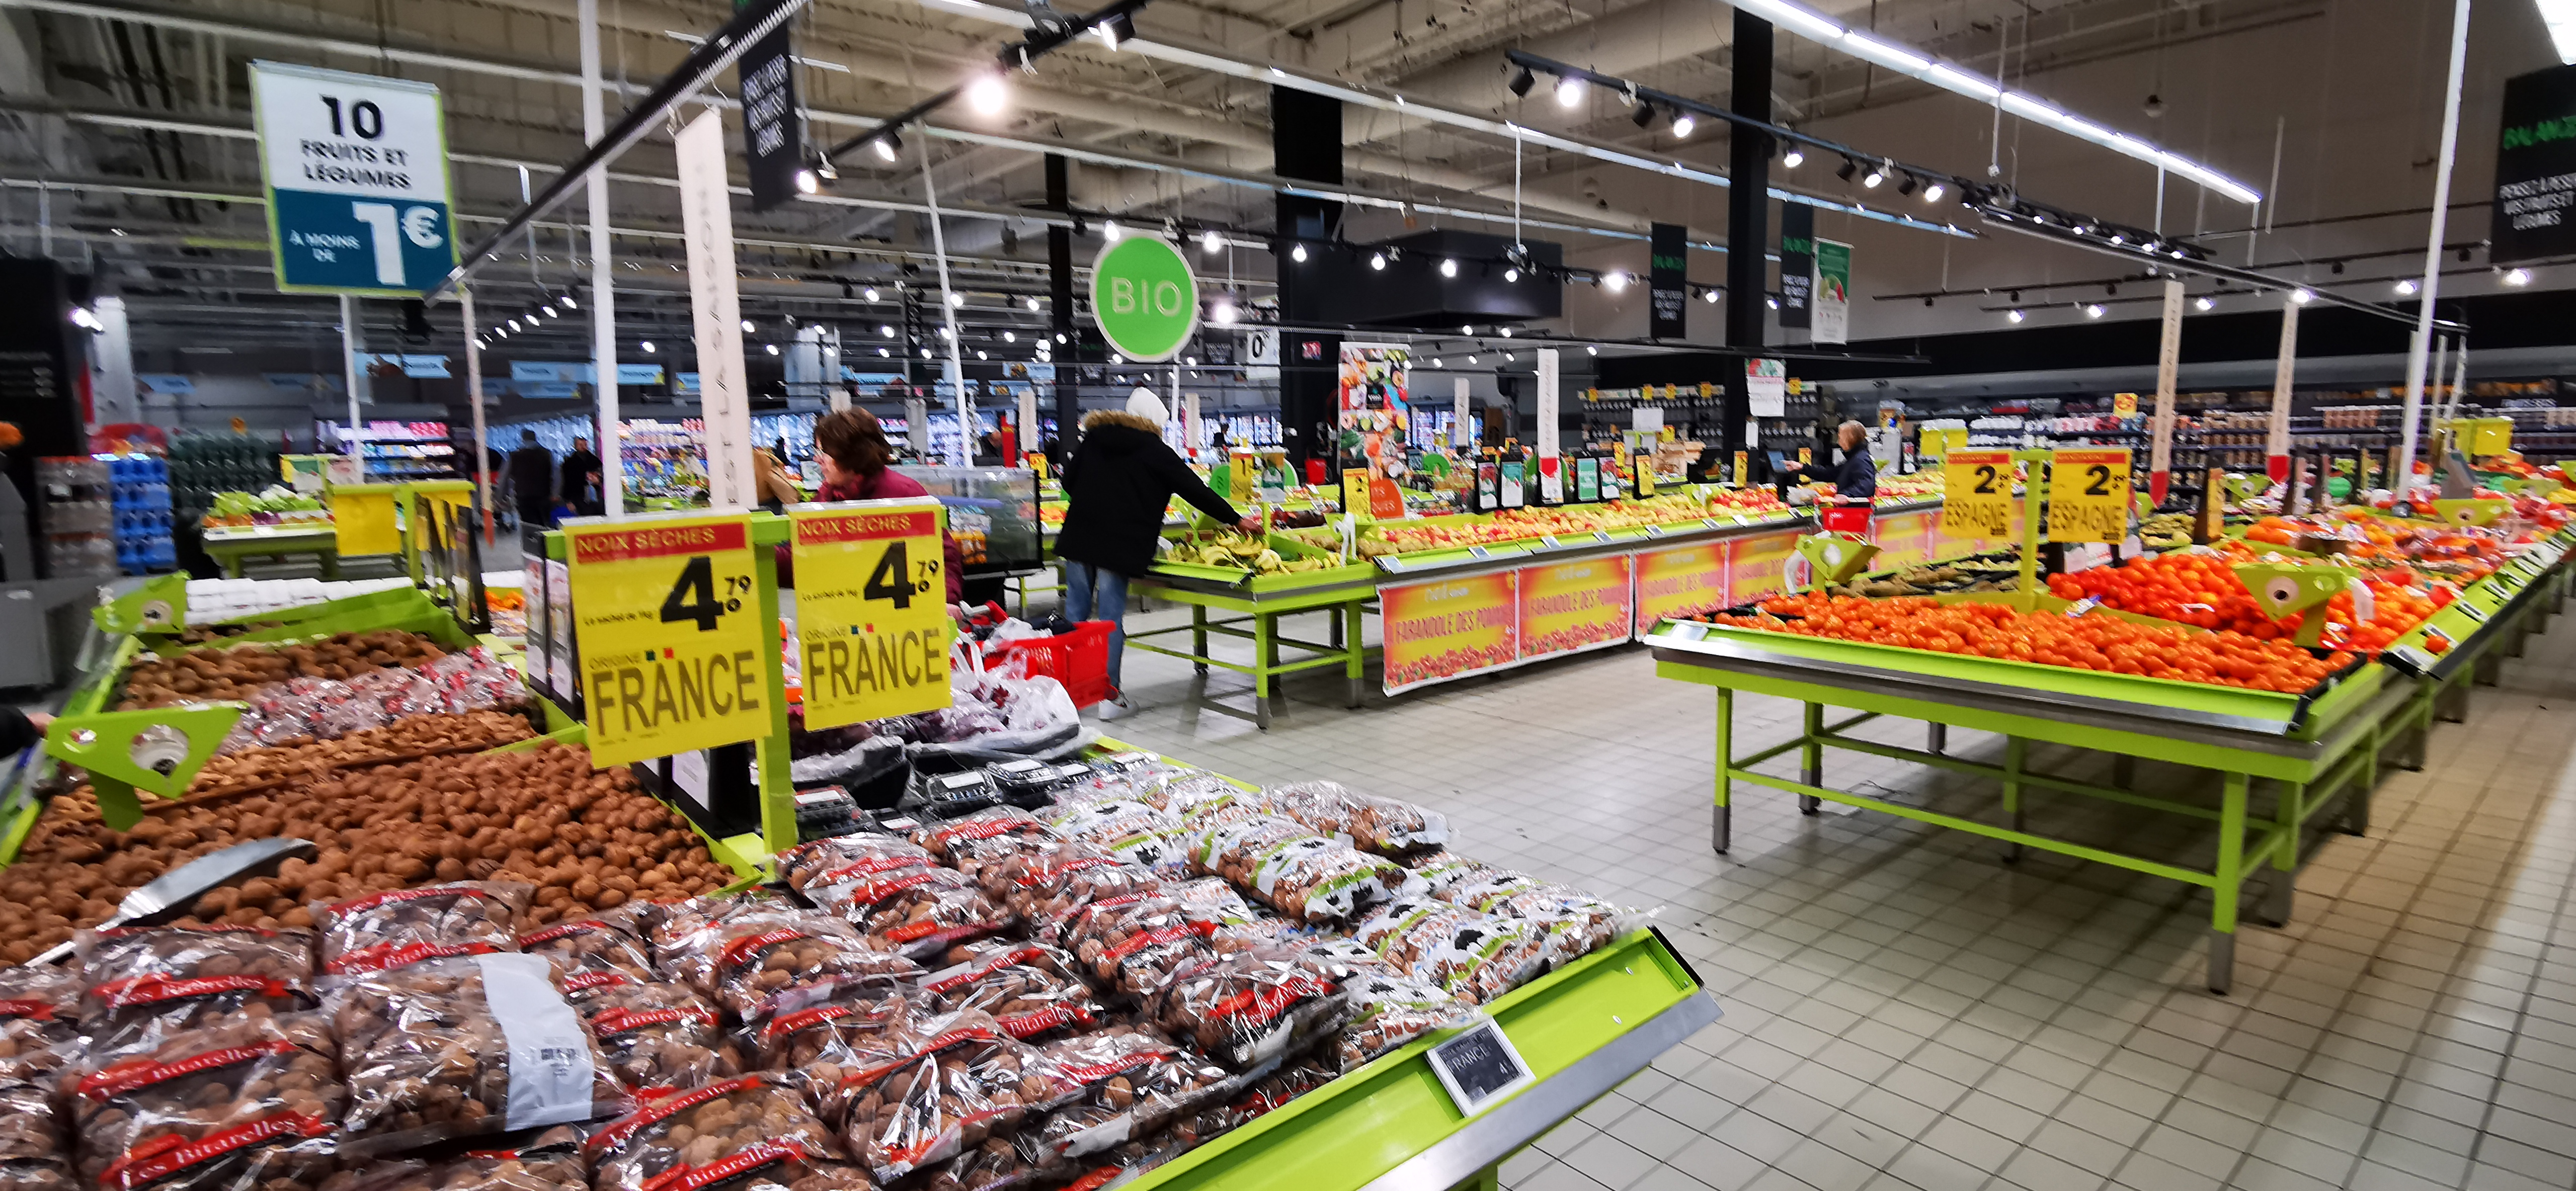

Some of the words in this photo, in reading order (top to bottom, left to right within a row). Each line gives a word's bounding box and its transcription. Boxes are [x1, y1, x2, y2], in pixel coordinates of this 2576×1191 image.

[319, 93, 385, 141] 10
[300, 139, 377, 162] FRUITS
[382, 147, 409, 167] ET
[303, 160, 412, 189] LÉGUMES
[304, 232, 361, 250] MOINS
[1110, 277, 1183, 318] BIO
[1973, 464, 1997, 495] 2
[2084, 464, 2111, 496] 2
[798, 520, 842, 537] NOIX
[845, 515, 912, 534] SÈCHES
[1944, 500, 2007, 530] ESPAGNE
[2050, 502, 2122, 533] ESPAGNE
[577, 534, 631, 555] NOIX
[634, 527, 716, 550] SÈCHES
[863, 540, 917, 610] 4
[660, 555, 726, 632] 4
[807, 628, 943, 701] FRANCE
[592, 649, 759, 737] FRANCE
[1445, 1042, 1491, 1075] FRANCE
[176, 1119, 296, 1164] Bitarelles
